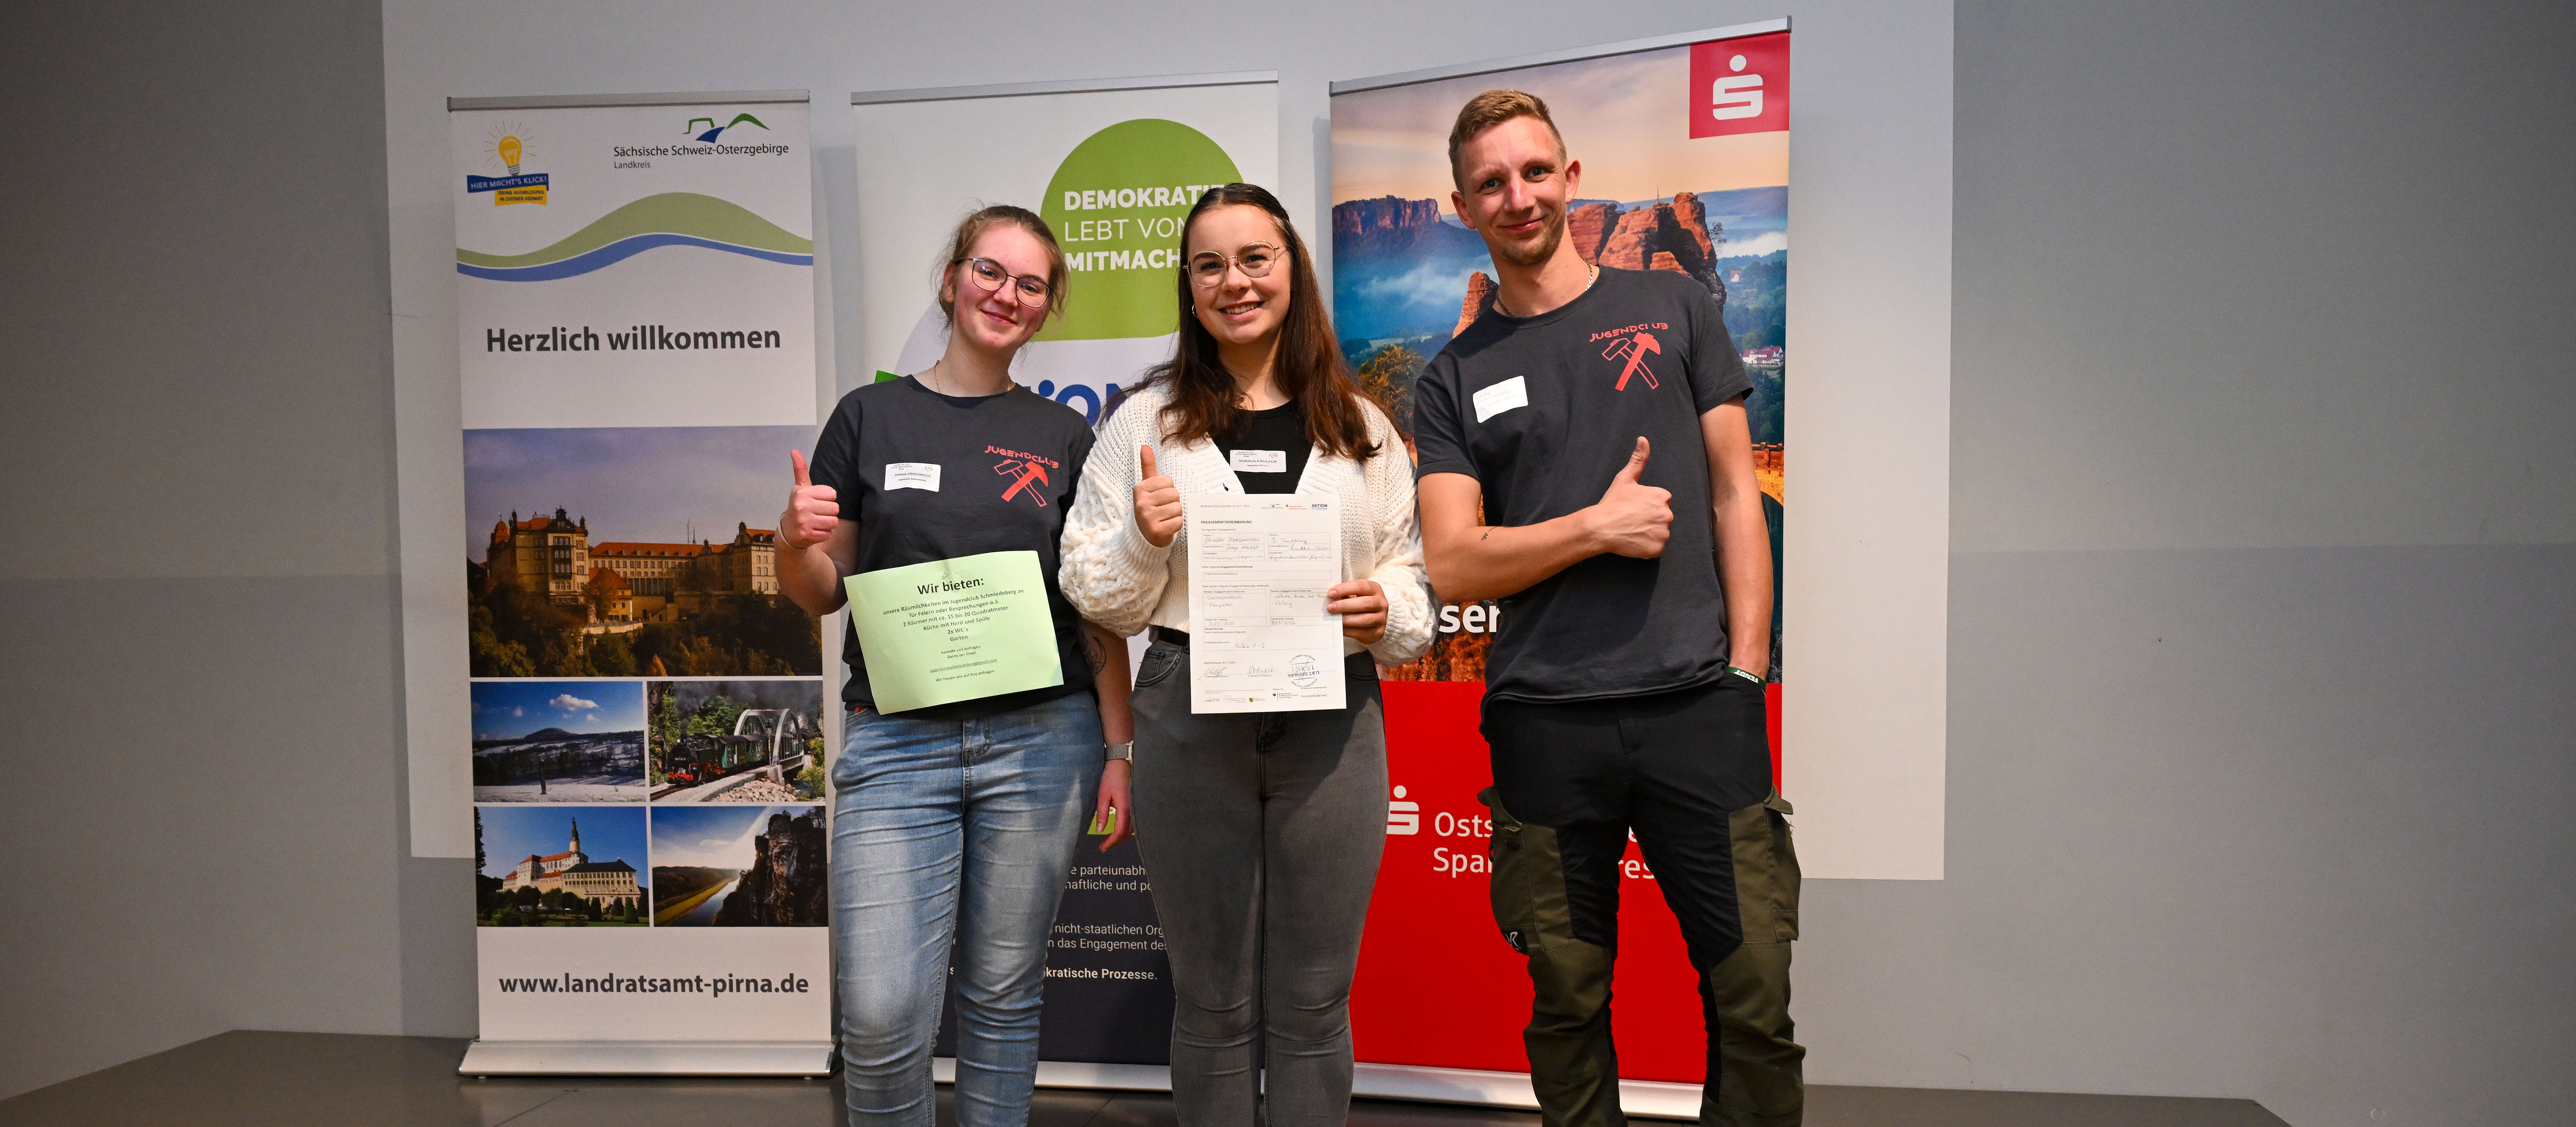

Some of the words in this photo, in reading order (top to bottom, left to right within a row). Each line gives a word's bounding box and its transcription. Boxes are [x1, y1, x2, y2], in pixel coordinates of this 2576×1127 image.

[614, 146, 669, 156] Sächsische
[671, 143, 789, 156] Schweiz-Osterzgebirge
[490, 178, 522, 187] MACHT'S
[1065, 185, 1224, 210] DEMOKRAT
[1065, 219, 1129, 241] LEBT
[487, 327, 599, 352] Herzlich
[607, 325, 780, 350] willkommen
[985, 445, 1059, 468] JUGENDCLUB
[917, 583, 939, 594] Wir
[943, 578, 984, 592] bieten:
[901, 602, 941, 612] Räumlichkeiten
[950, 595, 979, 604] Jugendclub
[980, 590, 1016, 599] Schmiedeberg
[949, 601, 988, 611] Besprechungen
[971, 606, 1008, 616] Quadratmeter
[930, 659, 997, 673] jugendclubschmiedeberg@gmail.com
[1080, 865, 1145, 877] parteiunabh
[1116, 880, 1136, 890] und
[1055, 923, 1142, 935] nicht-staatlichen
[1058, 938, 1077, 948] das
[1080, 939, 1147, 951] Engagement
[1044, 967, 1098, 978] kratische
[1102, 968, 1157, 980] Prozesse.
[500, 973, 808, 998] www.landratsamt-pirna.de
